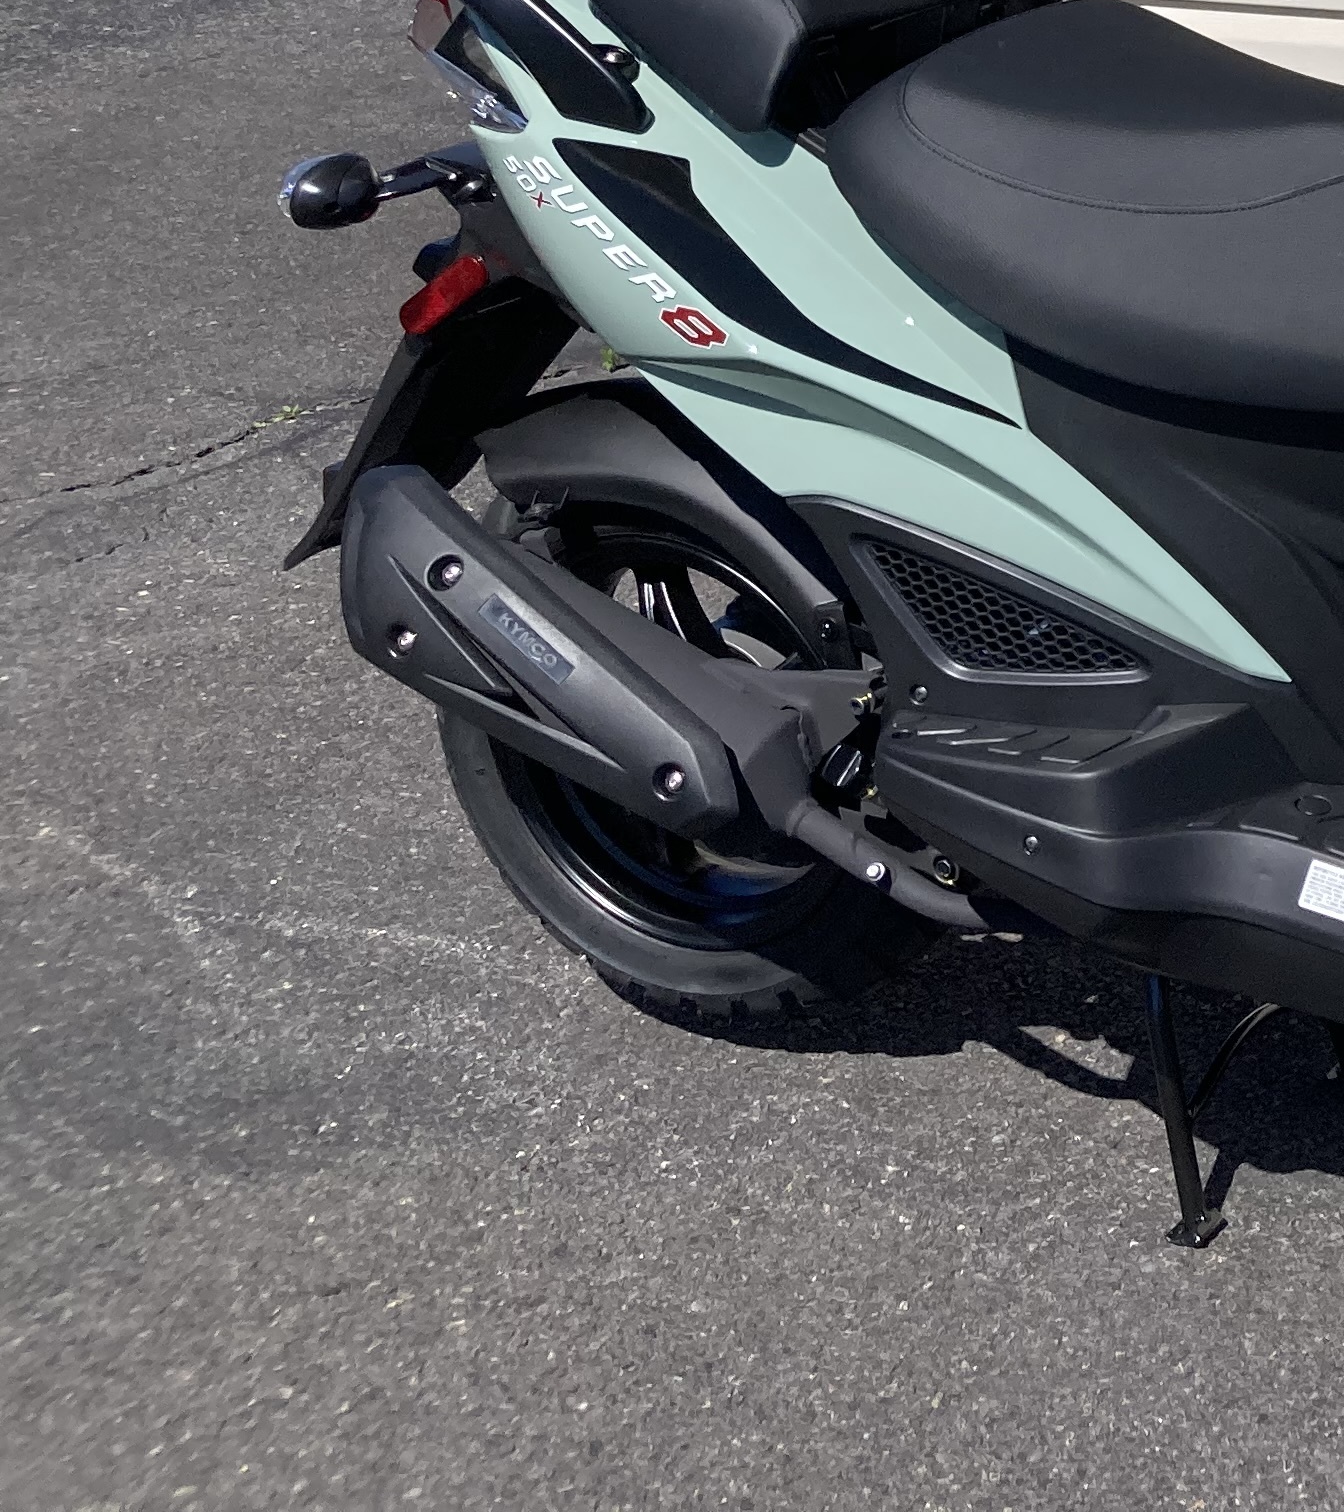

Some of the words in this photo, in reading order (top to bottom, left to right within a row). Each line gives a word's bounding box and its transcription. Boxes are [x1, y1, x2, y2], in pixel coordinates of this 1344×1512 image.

[503, 155, 556, 211] 50X
[523, 155, 677, 303] SUPER
[497, 611, 559, 669] KYMCO
